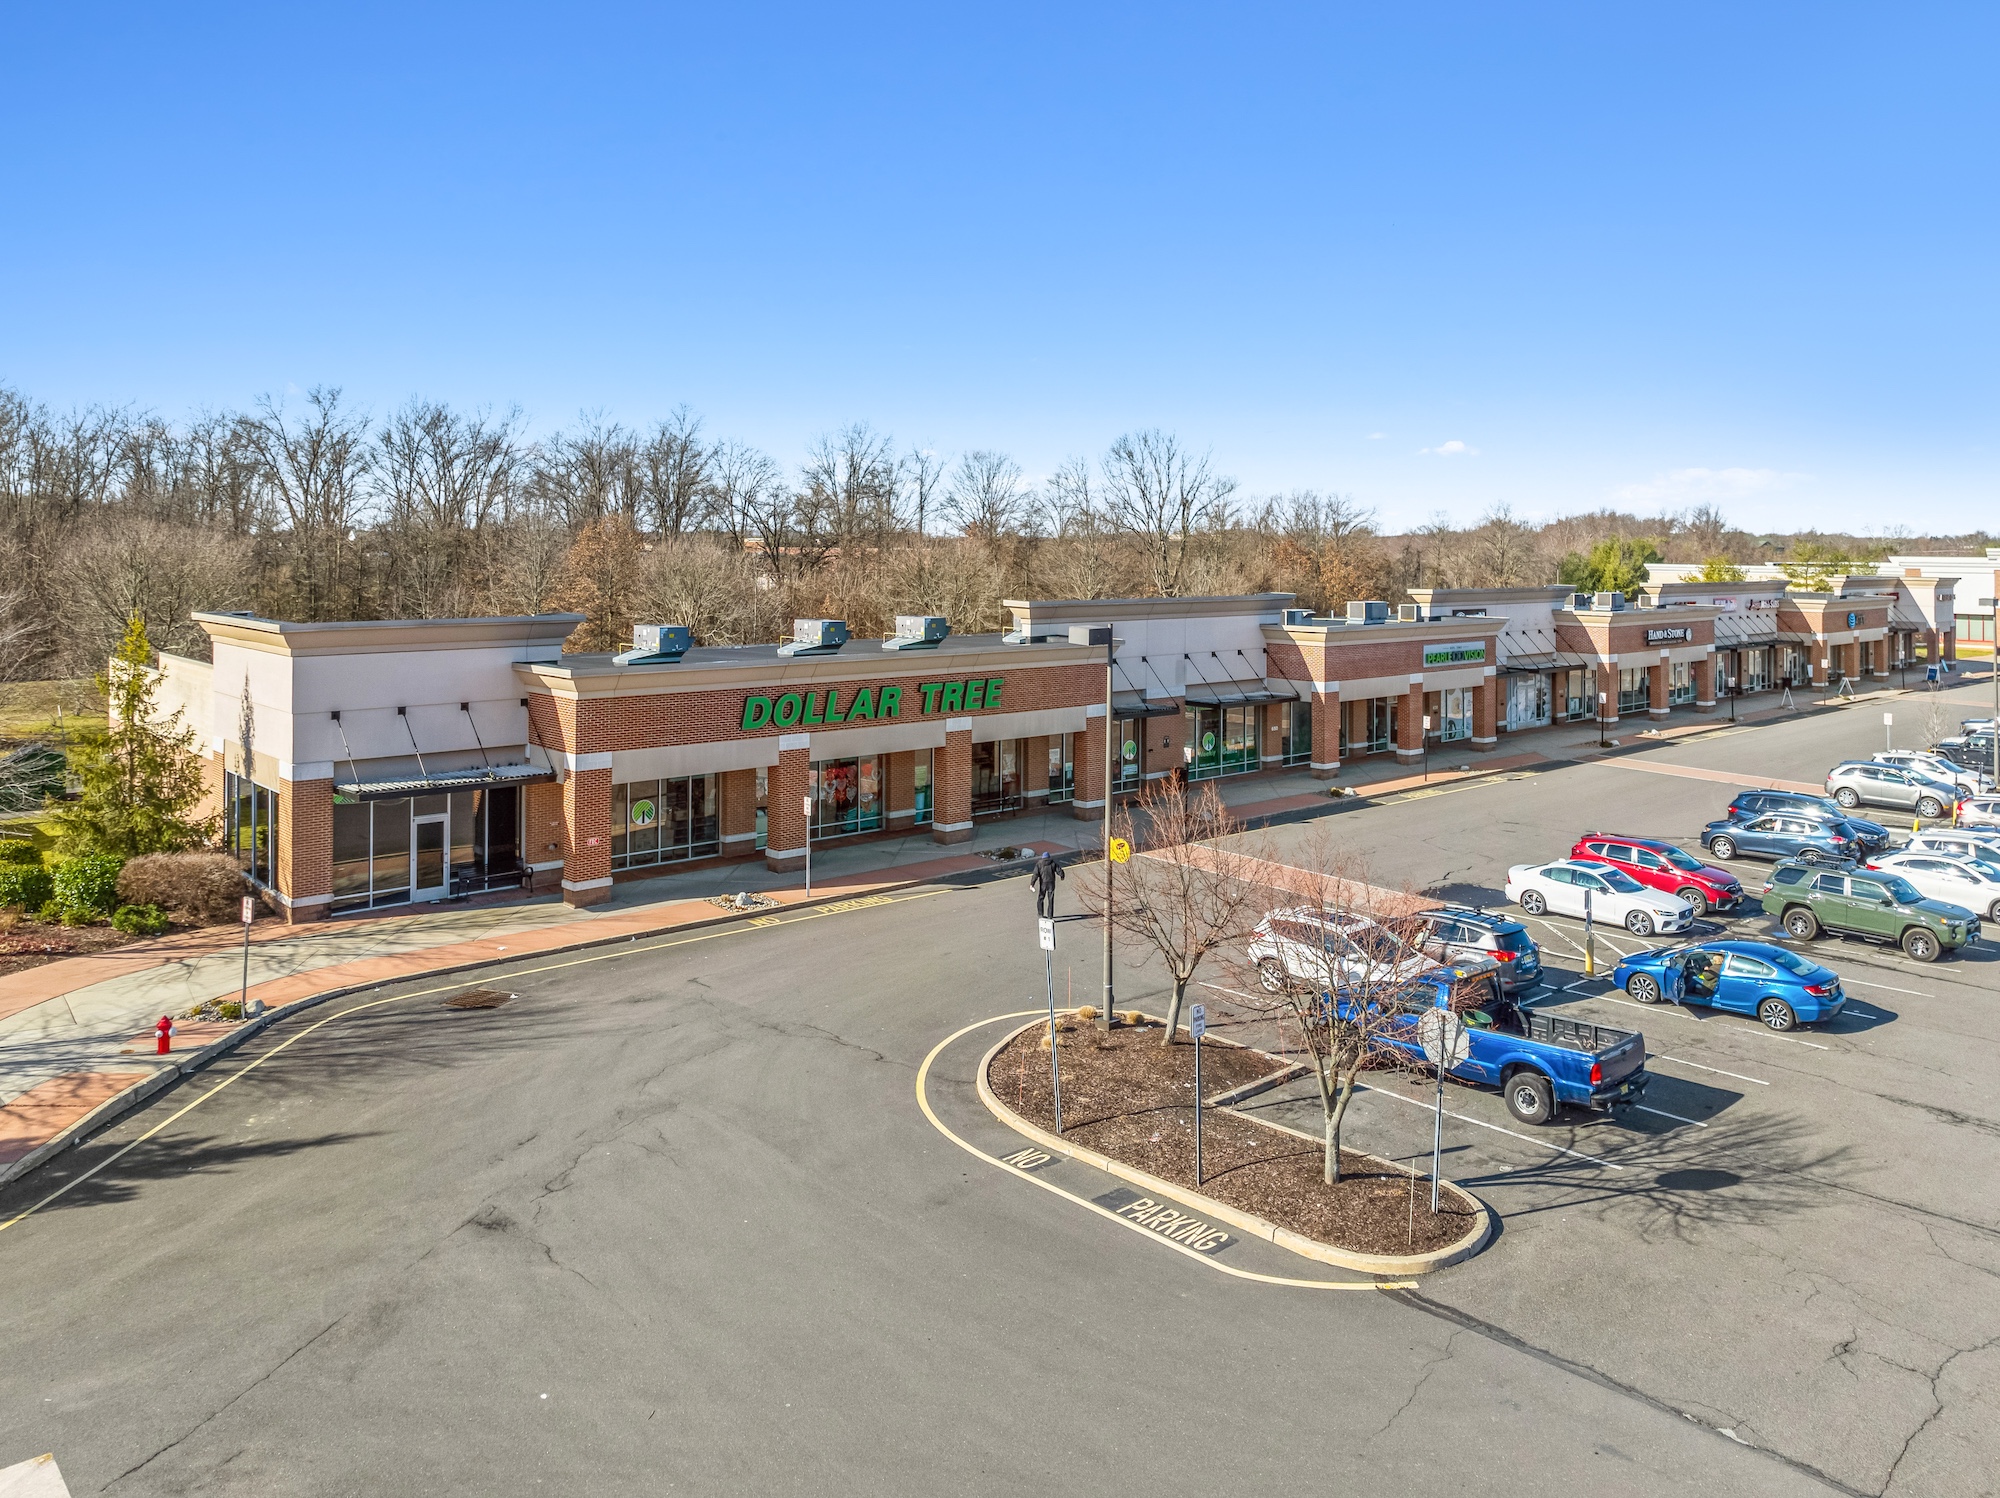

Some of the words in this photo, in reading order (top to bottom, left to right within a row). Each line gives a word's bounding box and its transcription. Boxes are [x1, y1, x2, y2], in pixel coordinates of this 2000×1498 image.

[1648, 630, 1663, 640] HAND
[1667, 629, 1685, 639] STONE
[1426, 652, 1453, 664] PEARLE
[1464, 649, 1485, 661] VISION
[741, 687, 902, 730] DOLLAR
[919, 679, 1004, 714] TREE
[746, 915, 781, 926] NO
[812, 895, 893, 914] PARKING
[1002, 1147, 1051, 1169] NO
[1116, 1197, 1230, 1251] PARKING
